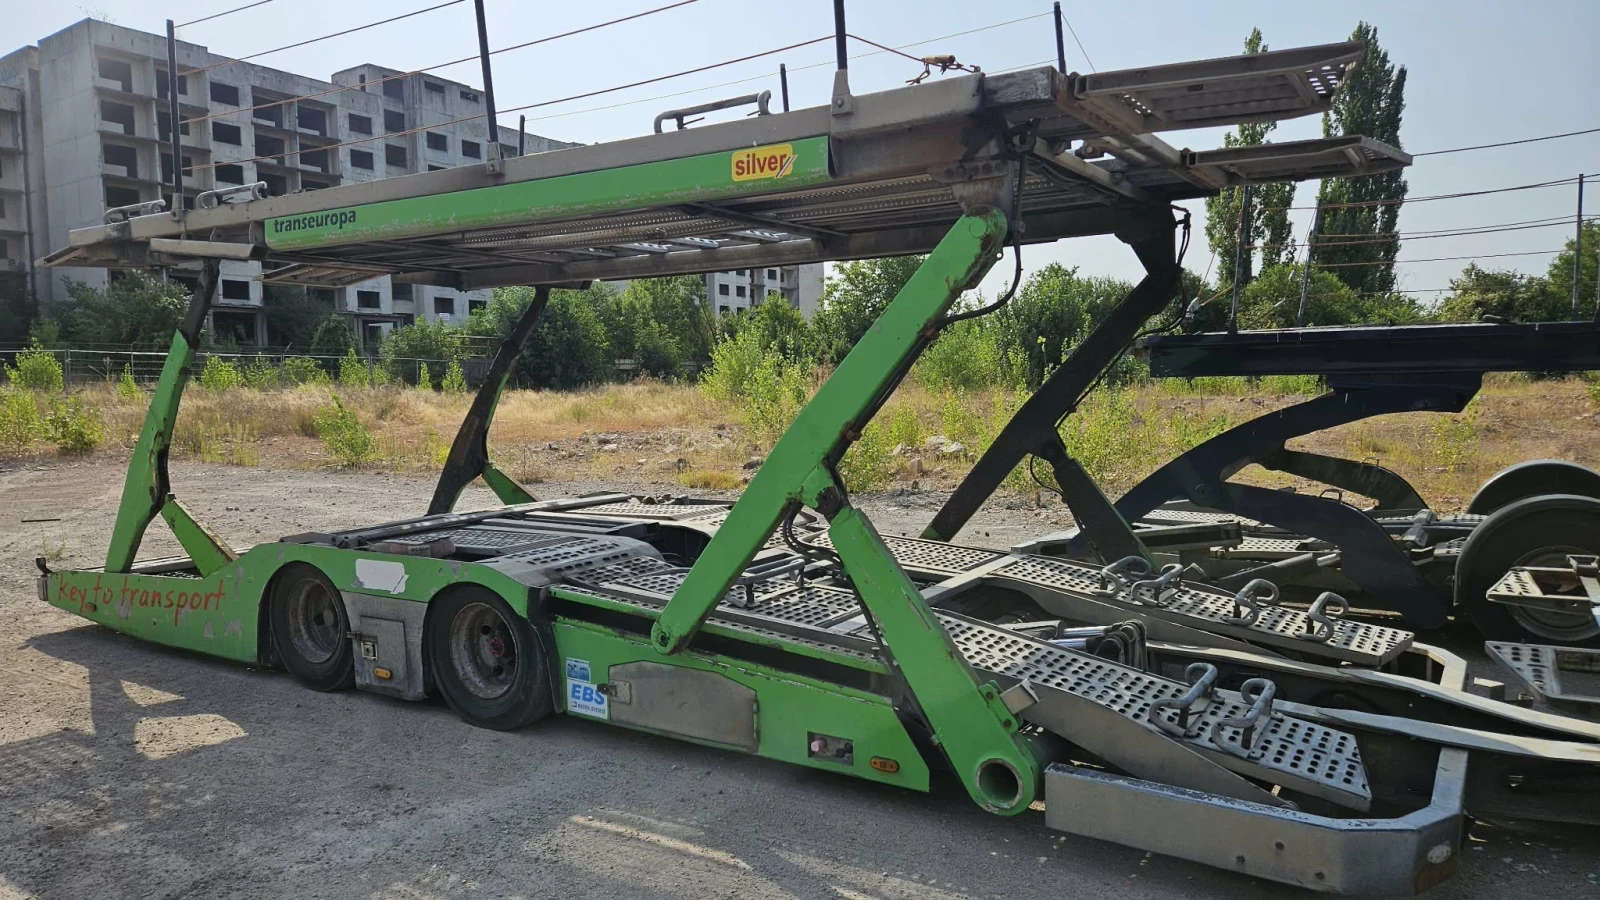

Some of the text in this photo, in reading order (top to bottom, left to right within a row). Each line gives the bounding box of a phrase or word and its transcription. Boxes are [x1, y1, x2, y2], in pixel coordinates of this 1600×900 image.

[735, 153, 787, 176] silver
[274, 210, 356, 233] transeuropa
[93, 577, 113, 604] to
[121, 576, 225, 627] transport
[571, 684, 605, 706] EBS
